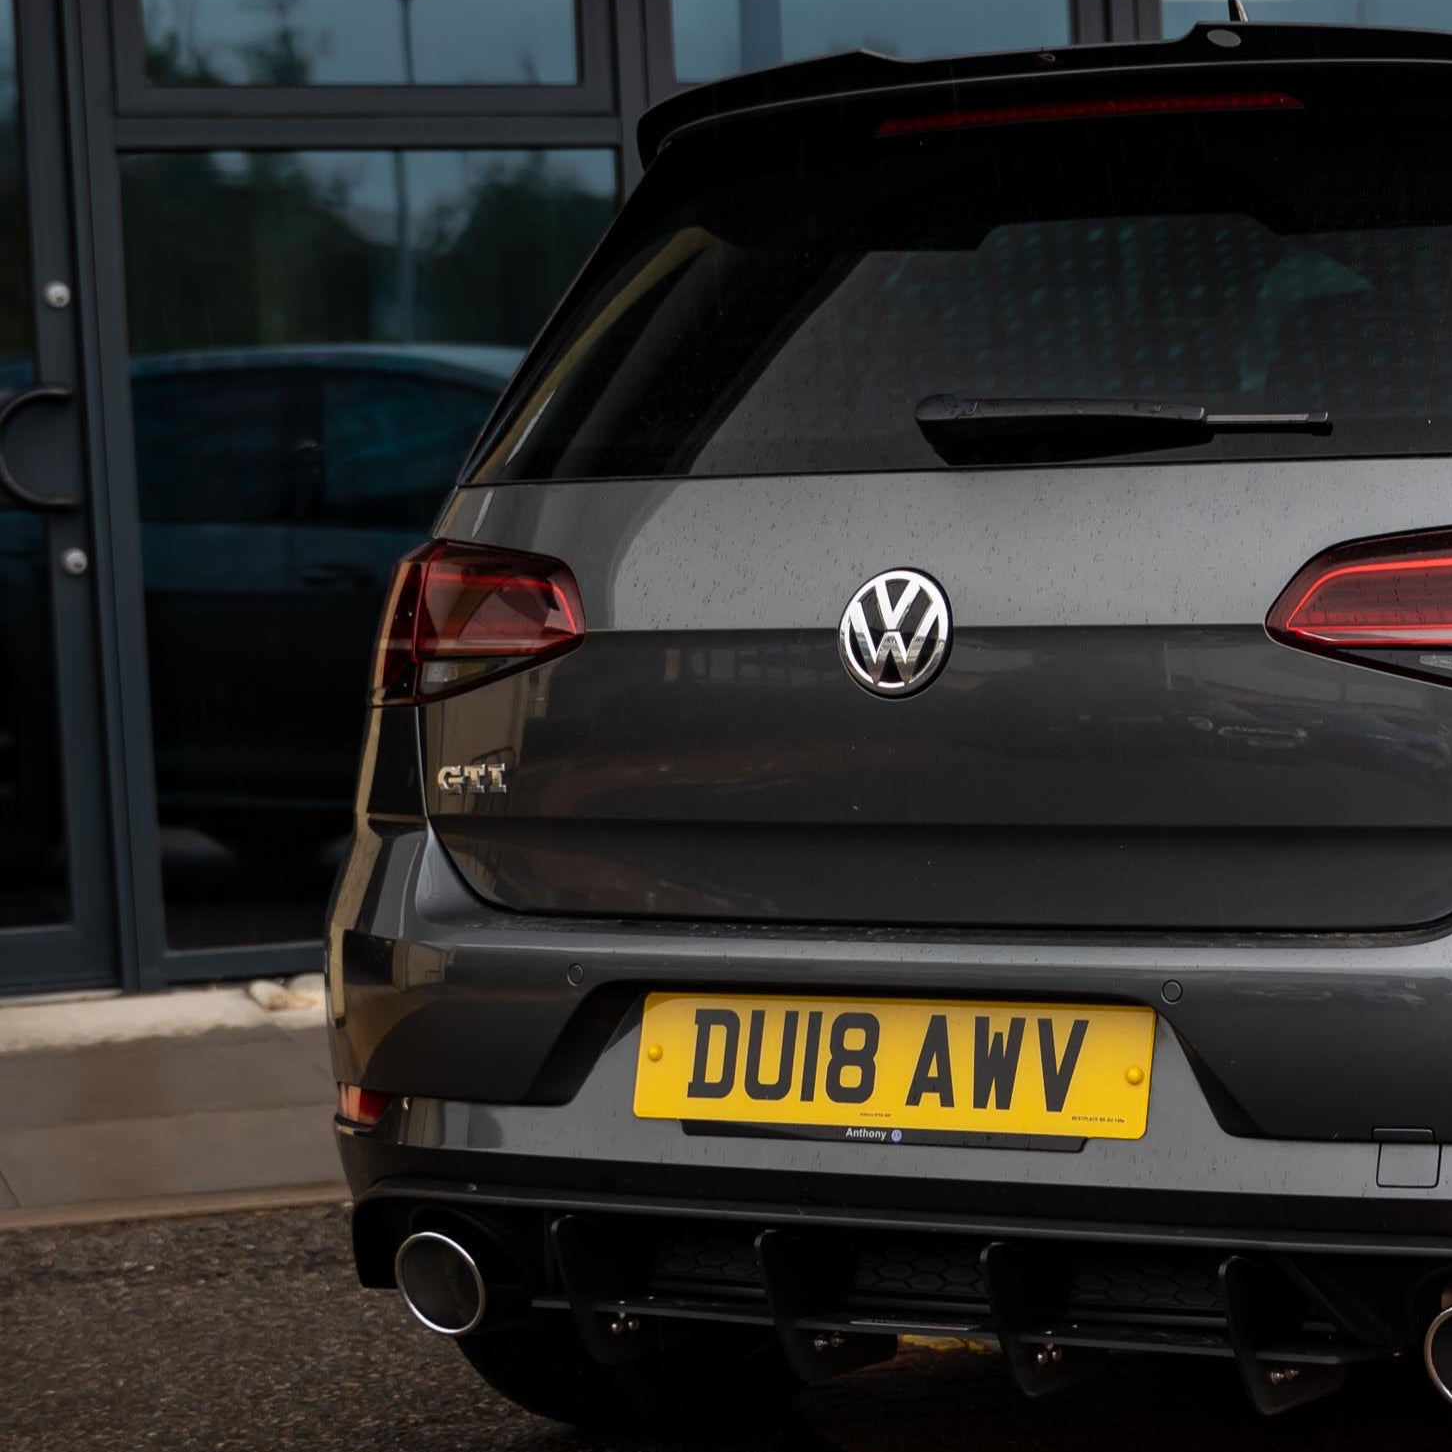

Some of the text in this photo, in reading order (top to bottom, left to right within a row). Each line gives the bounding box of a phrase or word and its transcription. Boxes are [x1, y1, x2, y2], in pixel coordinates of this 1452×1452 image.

[436, 763, 508, 795] GTI
[686, 1007, 1090, 1114] DU18 AWV
[845, 1127, 887, 1141] Anthony
